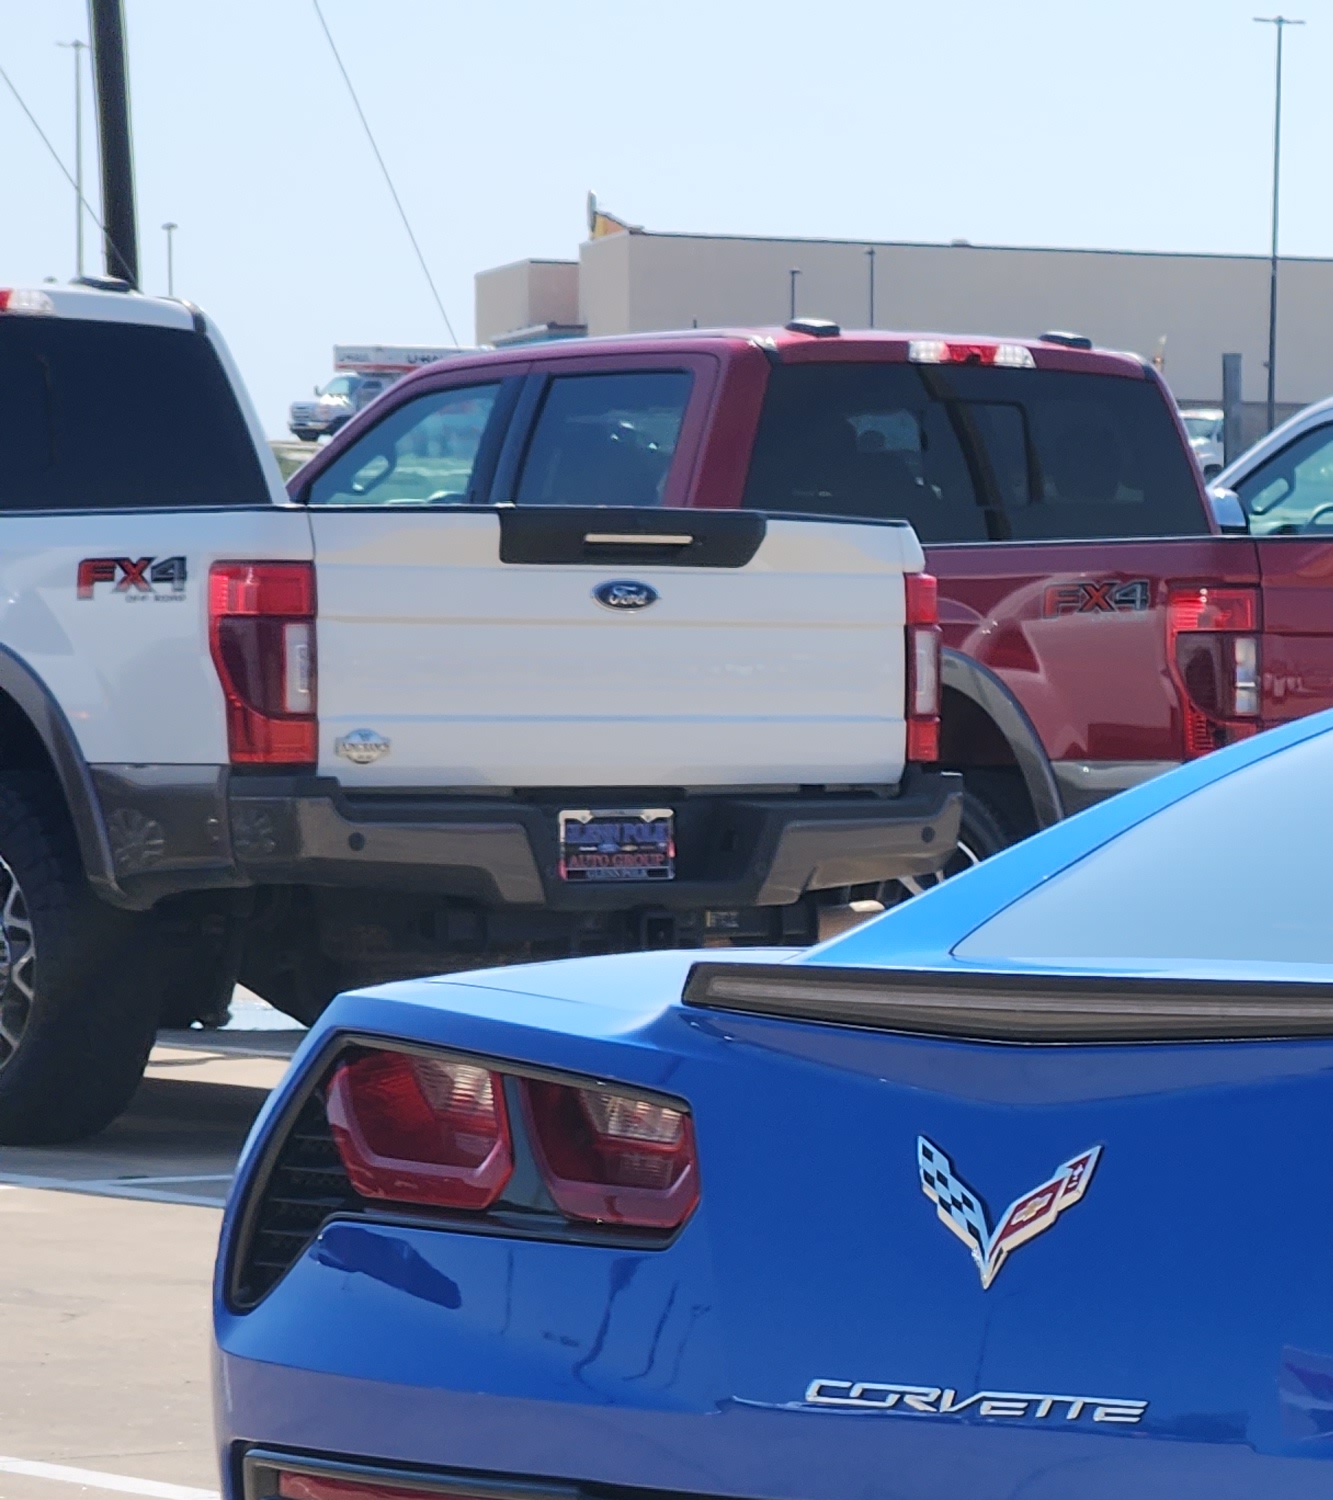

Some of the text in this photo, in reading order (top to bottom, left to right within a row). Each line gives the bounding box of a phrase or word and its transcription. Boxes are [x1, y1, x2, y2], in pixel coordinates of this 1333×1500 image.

[77, 556, 187, 601] FX4
[608, 585, 648, 605] Ford
[1042, 580, 1150, 620] FX4
[806, 1378, 1148, 1423] CORVETTE
